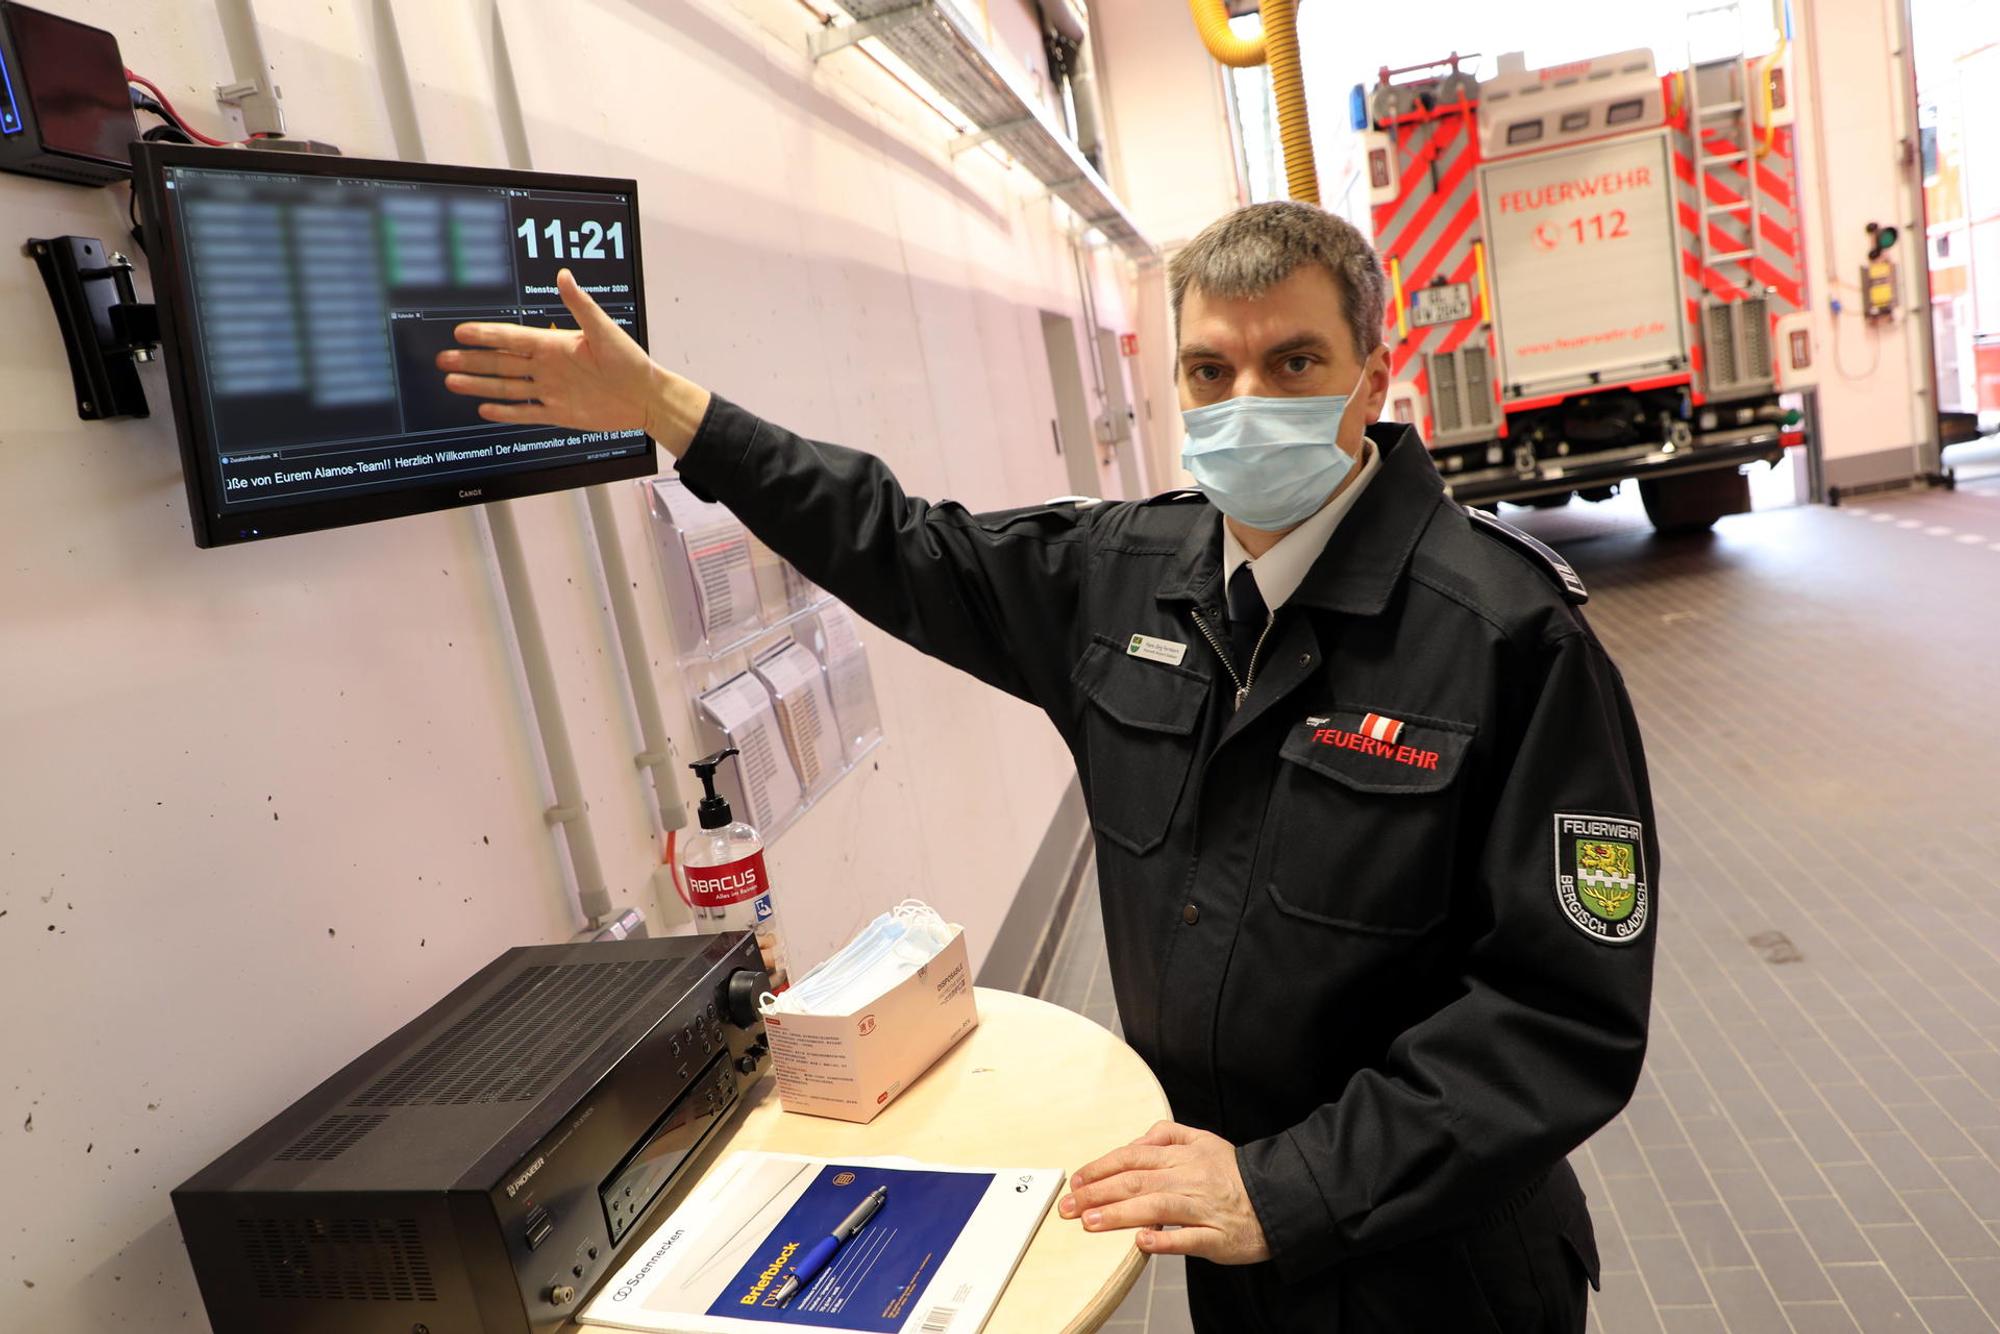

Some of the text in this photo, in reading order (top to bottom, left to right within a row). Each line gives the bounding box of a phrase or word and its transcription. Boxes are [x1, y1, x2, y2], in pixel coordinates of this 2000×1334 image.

[1499, 166, 1651, 213] FEUERWEHR
[517, 218, 625, 259] 11:21
[1569, 208, 1629, 245] 112
[576, 284, 611, 293] ovember
[612, 284, 629, 292] 2020
[251, 477, 272, 487] von
[274, 471, 312, 484] Eurem
[394, 452, 434, 468] Herzlich
[436, 446, 493, 463] Willkommen!
[496, 442, 511, 456] Der
[513, 437, 566, 453] Alarmmonitor
[567, 437, 581, 446] des
[582, 432, 602, 444] FWH
[603, 431, 609, 441] 8
[610, 431, 619, 440] ist
[1311, 728, 1440, 770] FEUERWEHR
[1563, 820, 1639, 840] FEUERWEHR
[689, 868, 756, 893] ABACUS
[1560, 874, 1646, 937] BERGISCH GLADBACH
[513, 1157, 545, 1191] PIONEER
[626, 1227, 686, 1287] Soennecken
[740, 1241, 800, 1305] Briefblock
